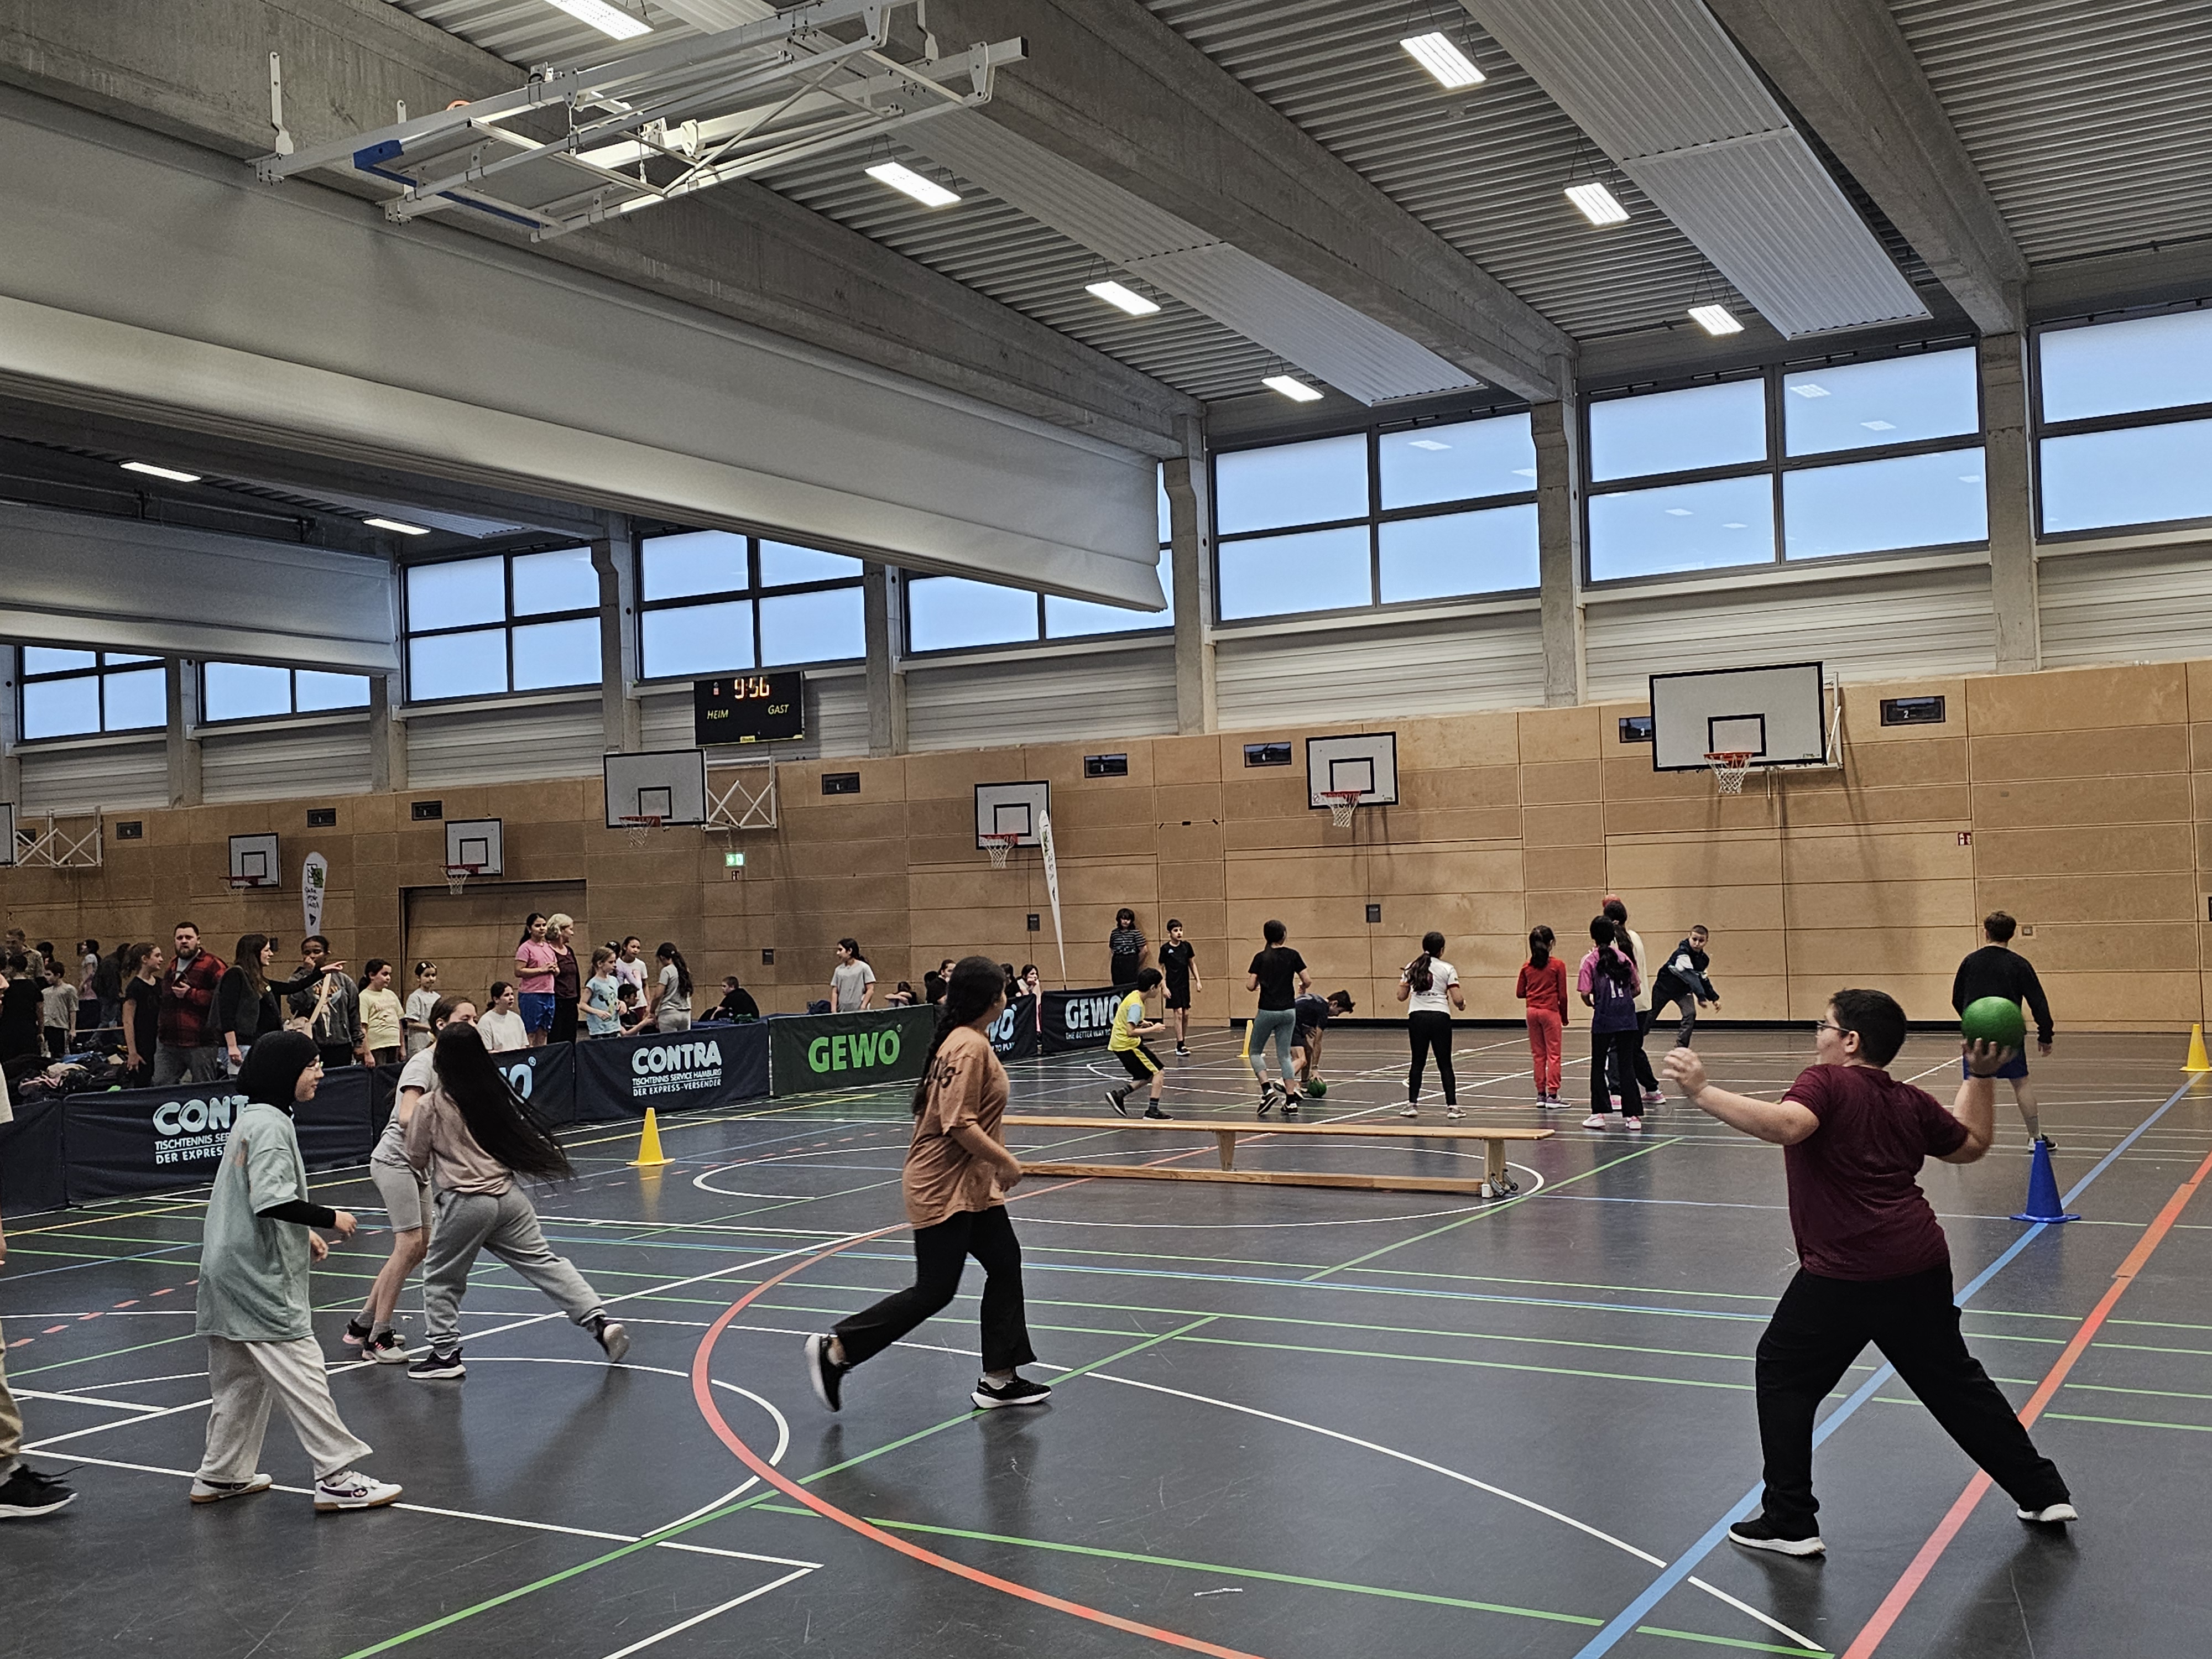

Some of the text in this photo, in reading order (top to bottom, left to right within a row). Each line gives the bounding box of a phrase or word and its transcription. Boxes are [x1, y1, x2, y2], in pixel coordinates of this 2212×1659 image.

[707, 709, 729, 720] HEIM
[768, 703, 790, 715] GAST
[1903, 710, 1909, 718] 2
[1076, 1030, 1093, 1039] BETTER
[632, 1040, 722, 1074] CONTRA
[632, 1068, 722, 1086] TISCHTENNIS SERVICE HAMBURG
[633, 1078, 721, 1097] DER EXPRESS-VERSENDER
[153, 1095, 249, 1135] CONT
[154, 1134, 213, 1151] TISCHTENNIS
[155, 1146, 223, 1165] DER EXPRES
